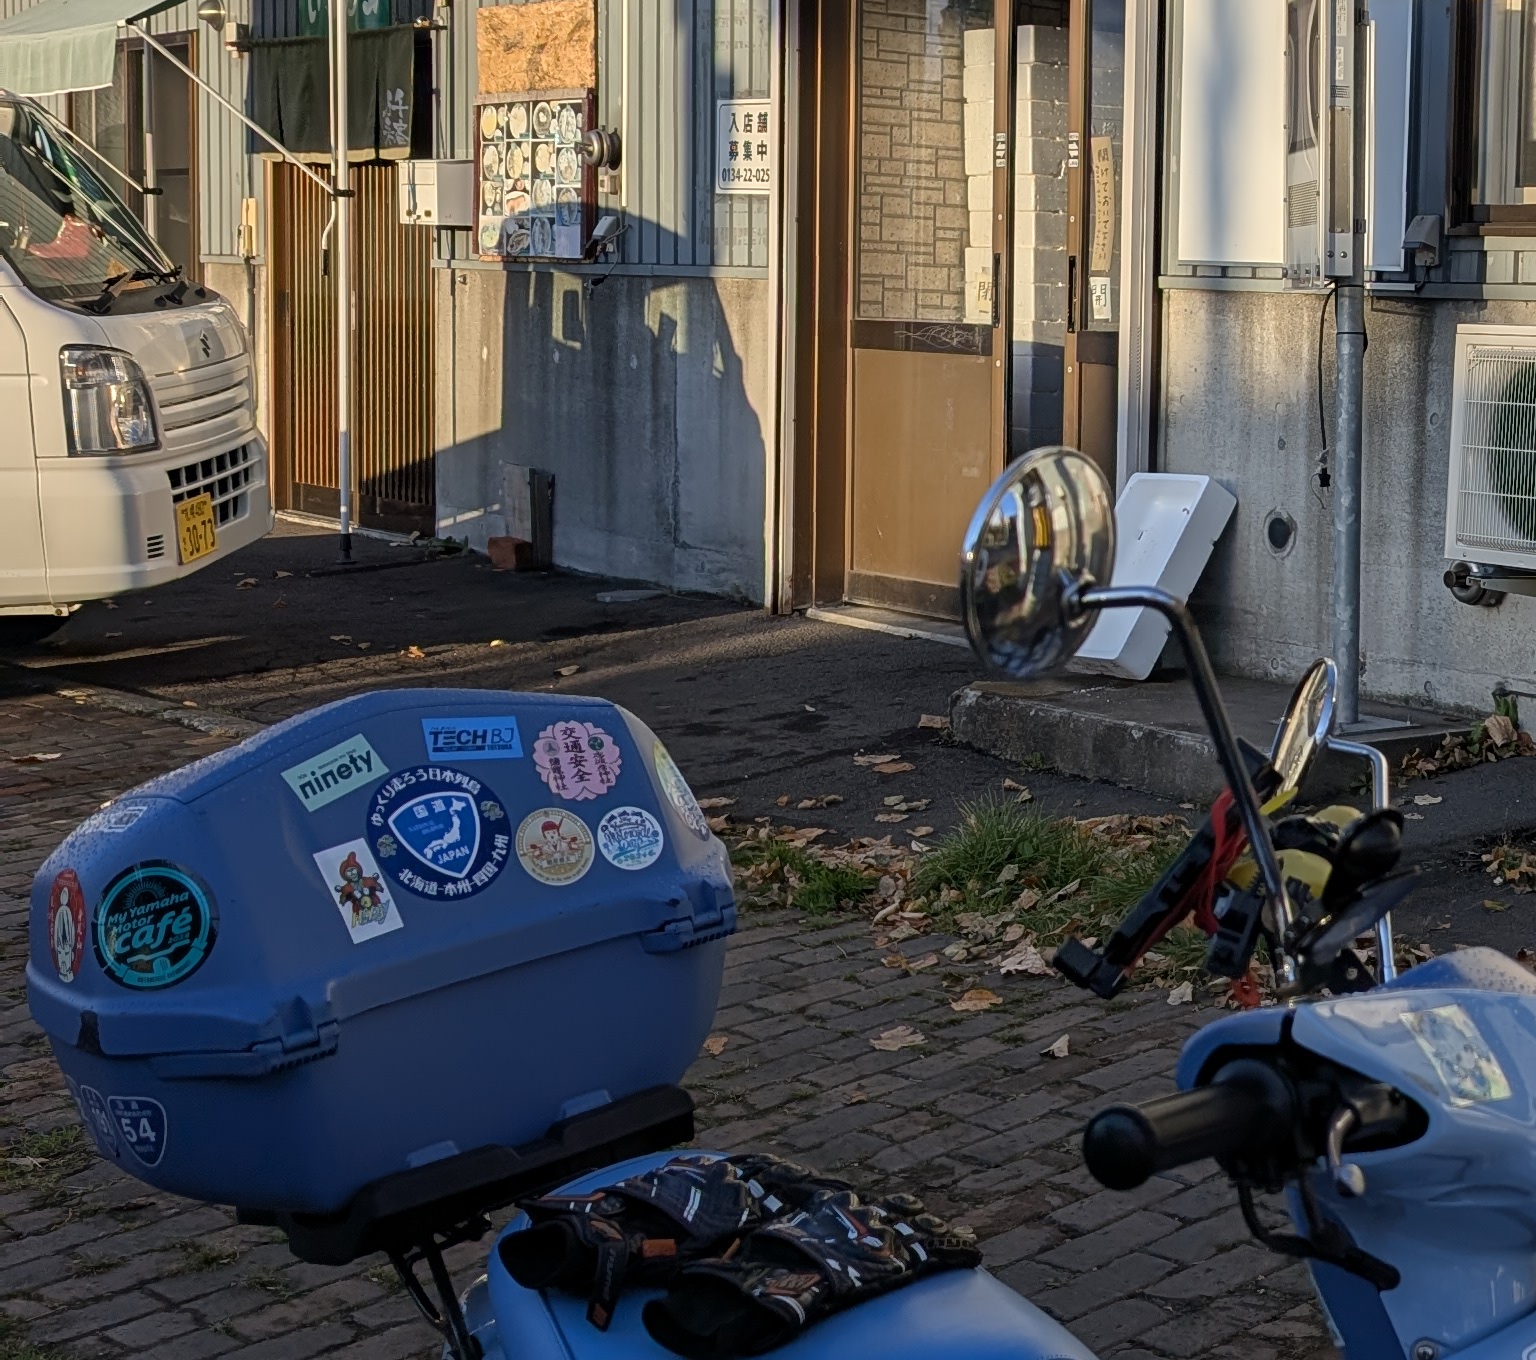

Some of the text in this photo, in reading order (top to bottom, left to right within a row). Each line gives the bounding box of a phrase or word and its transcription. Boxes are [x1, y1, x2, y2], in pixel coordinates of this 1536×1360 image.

[728, 140, 768, 162] 募集中
[428, 727, 515, 746] TECH BJ
[560, 726, 593, 784] 交通安全
[299, 749, 374, 800] ninety
[437, 845, 470, 865] JAPAN
[108, 891, 190, 927] My Yamaha
[112, 913, 155, 938] Motor
[114, 906, 193, 954] café
[120, 1117, 156, 1143] 54
